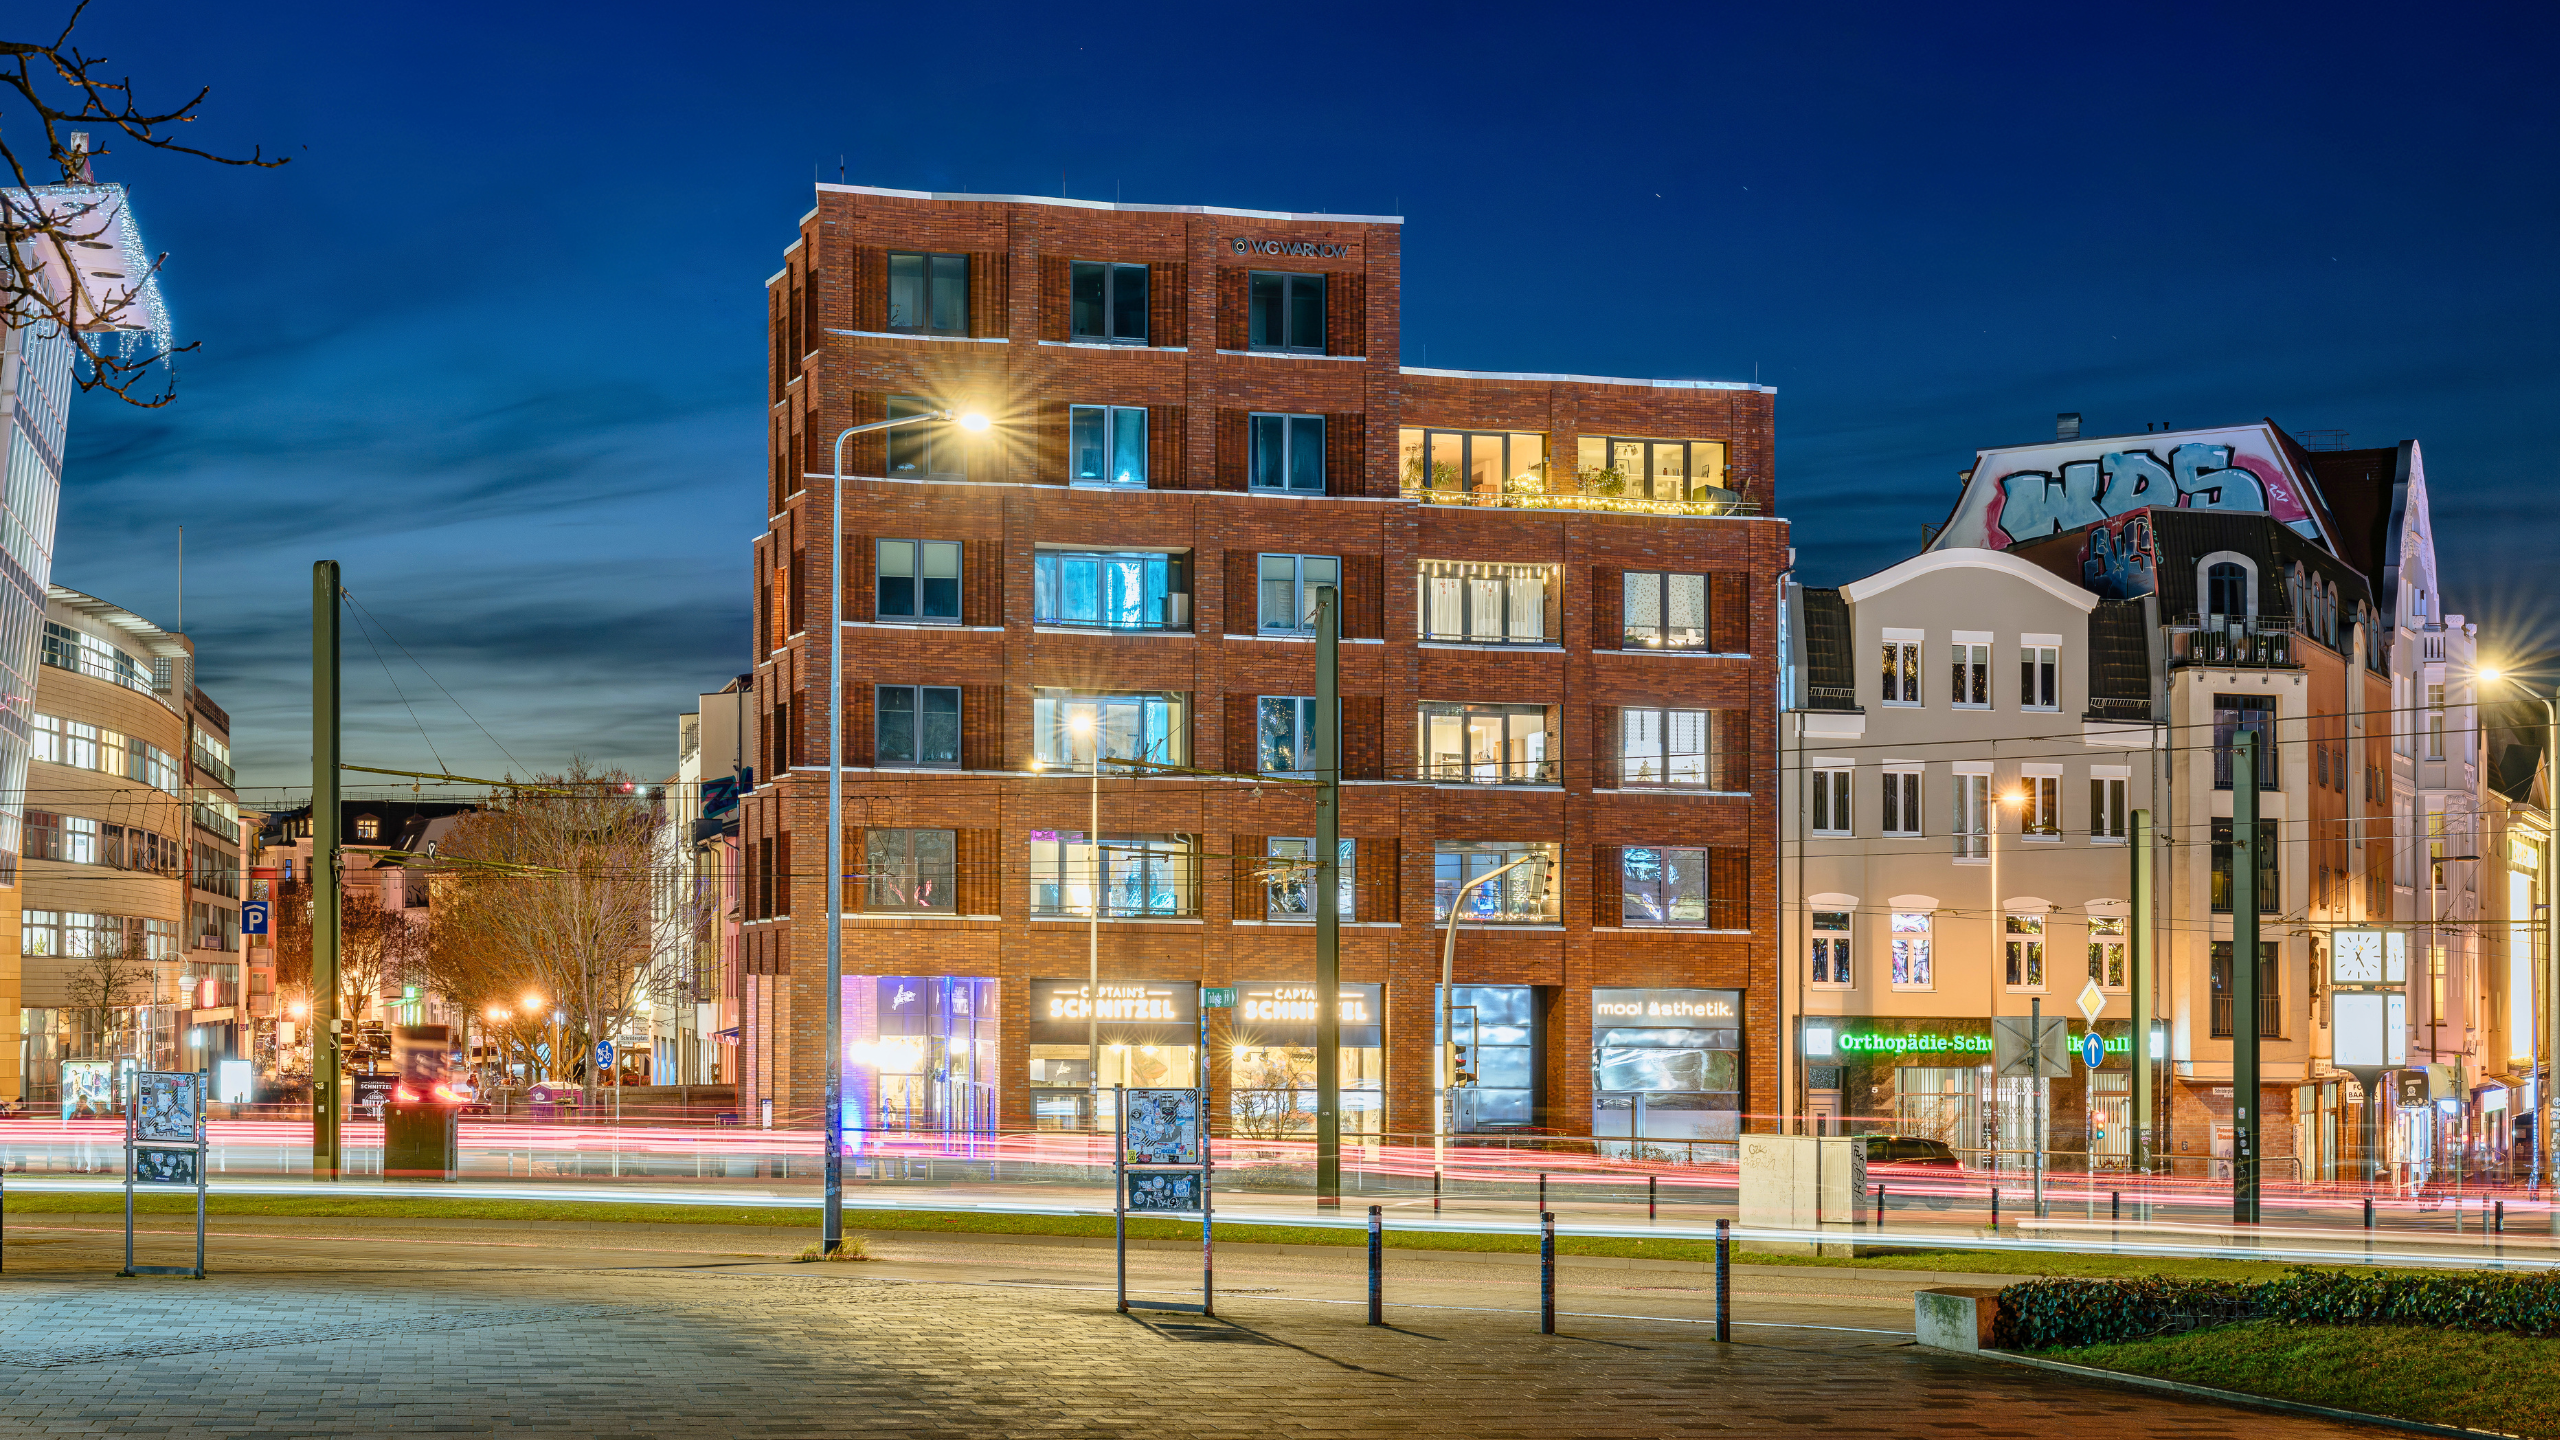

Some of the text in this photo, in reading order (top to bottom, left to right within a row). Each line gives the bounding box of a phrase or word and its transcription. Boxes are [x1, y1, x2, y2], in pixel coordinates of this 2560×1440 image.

[1251, 240, 1350, 259] WG WARNOW
[2000, 443, 2268, 542] WDS
[248, 909, 264, 931] P
[1080, 986, 1145, 998] CPTAIN'S
[1050, 998, 1175, 1018] SCHNITZEL
[1245, 1001, 1367, 1020] SCHNIEL
[1648, 1001, 1734, 1017] ästhetik.
[2104, 1037, 2131, 1052] ull
[1871, 1086, 1879, 1094] 5
